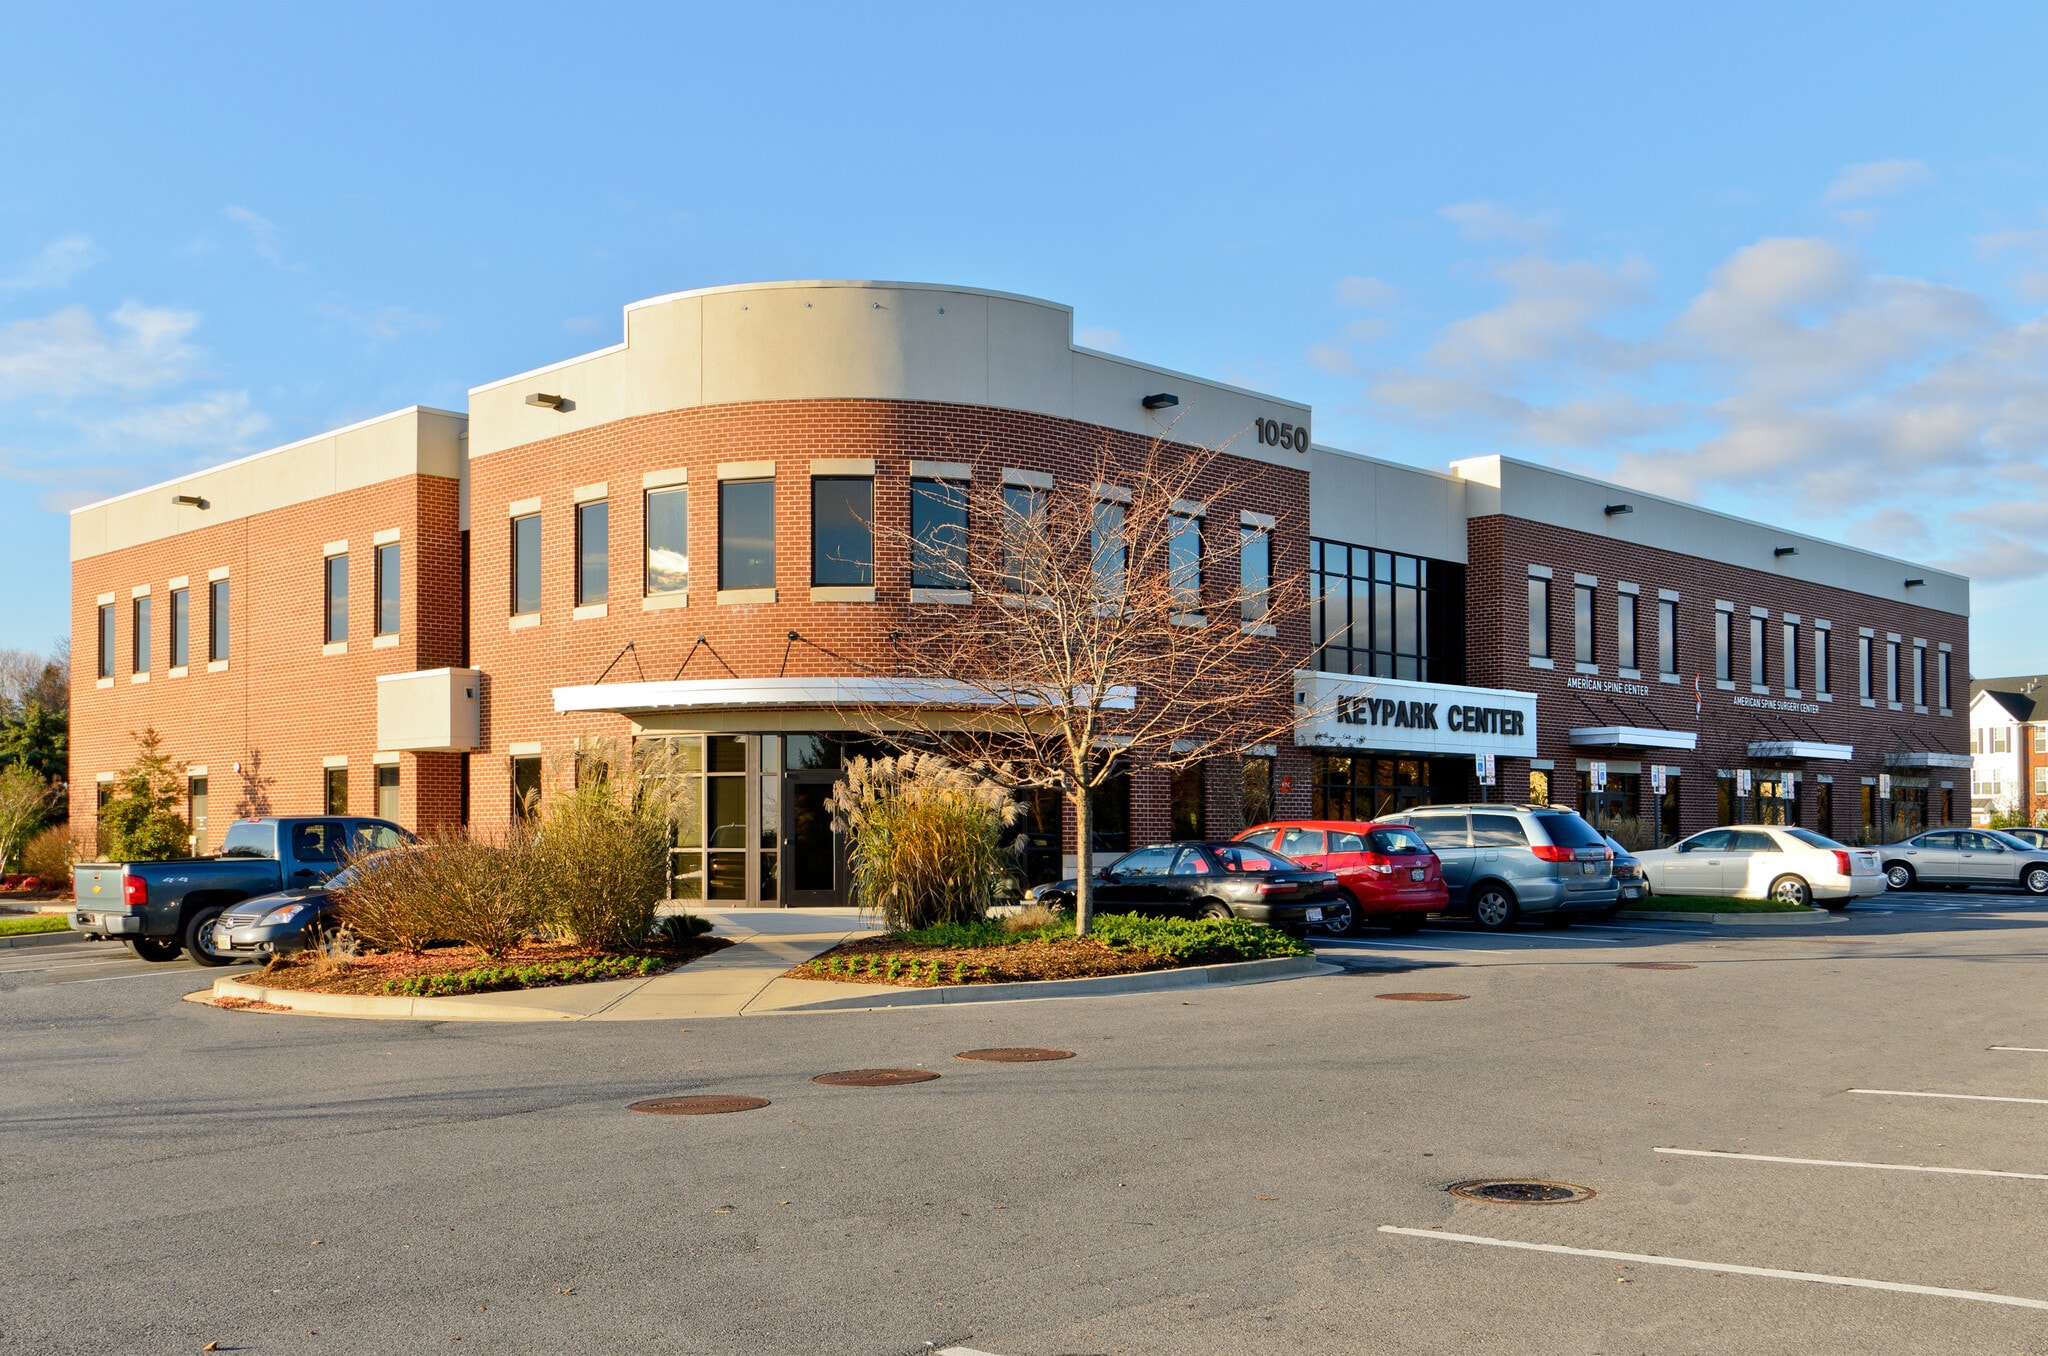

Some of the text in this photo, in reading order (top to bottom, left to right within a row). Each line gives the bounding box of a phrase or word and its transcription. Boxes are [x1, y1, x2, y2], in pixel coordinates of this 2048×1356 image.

[1255, 417, 1309, 454] 1050
[1567, 677, 1650, 696] AMERICAN SPINE CENTER
[1337, 694, 1524, 736] KEYPARK CENTER
[1733, 695, 1760, 708] AMERICAN
[1761, 699, 1777, 710] SPINE
[1800, 703, 1819, 714] CENTER
